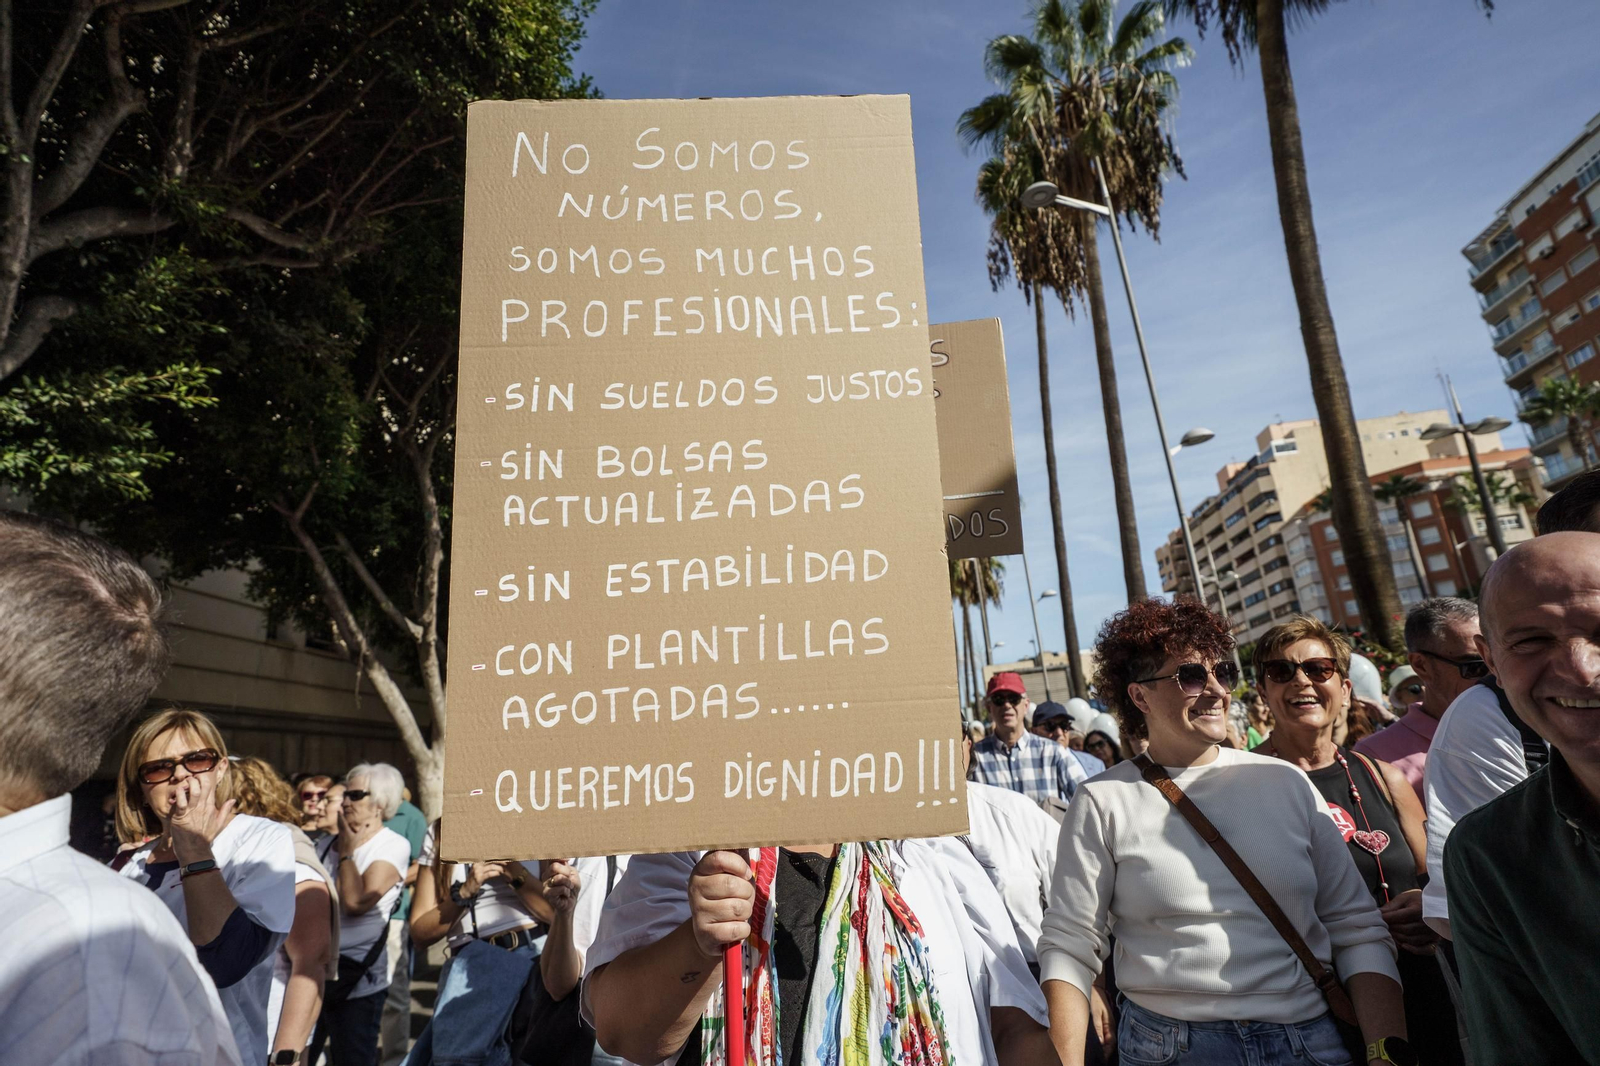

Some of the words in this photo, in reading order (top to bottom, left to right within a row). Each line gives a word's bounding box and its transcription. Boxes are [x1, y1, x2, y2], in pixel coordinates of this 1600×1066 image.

[509, 245, 665, 277] SOMOS
[696, 245, 874, 281] MUCHOS
[601, 376, 778, 409] SUELDOS
[807, 368, 922, 403] JUSTOS
[597, 440, 767, 478] BOLSAS
